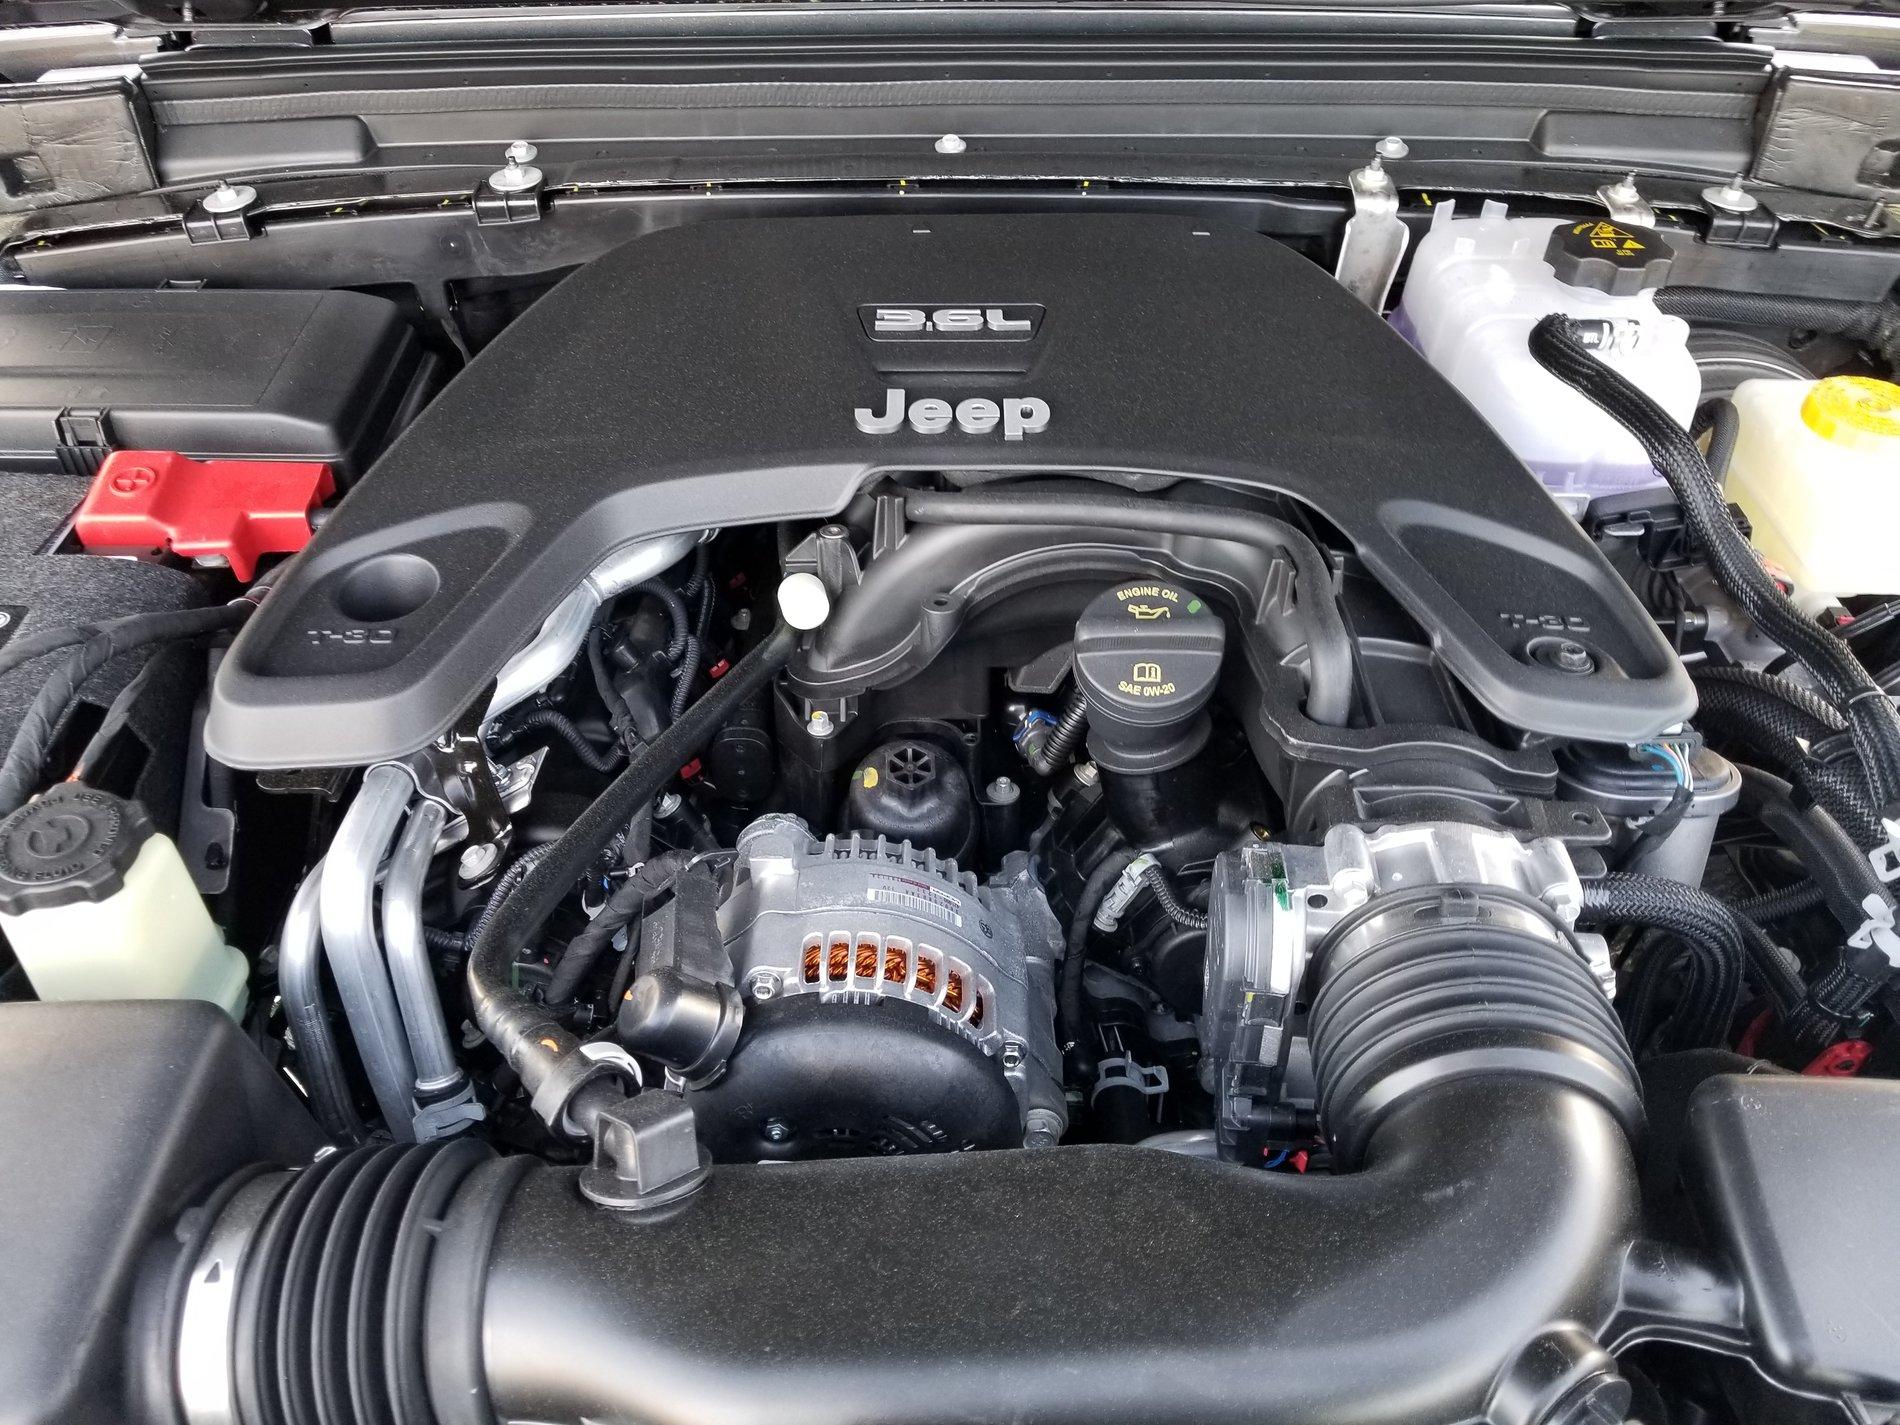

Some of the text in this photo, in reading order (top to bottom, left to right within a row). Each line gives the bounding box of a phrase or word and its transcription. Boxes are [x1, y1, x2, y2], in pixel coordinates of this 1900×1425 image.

[875, 309, 1031, 331] 3.6L
[854, 388, 1051, 441] Jeep
[1116, 586, 1179, 602] ENGINE OIL
[1118, 680, 1176, 697] SAE 0W-20
